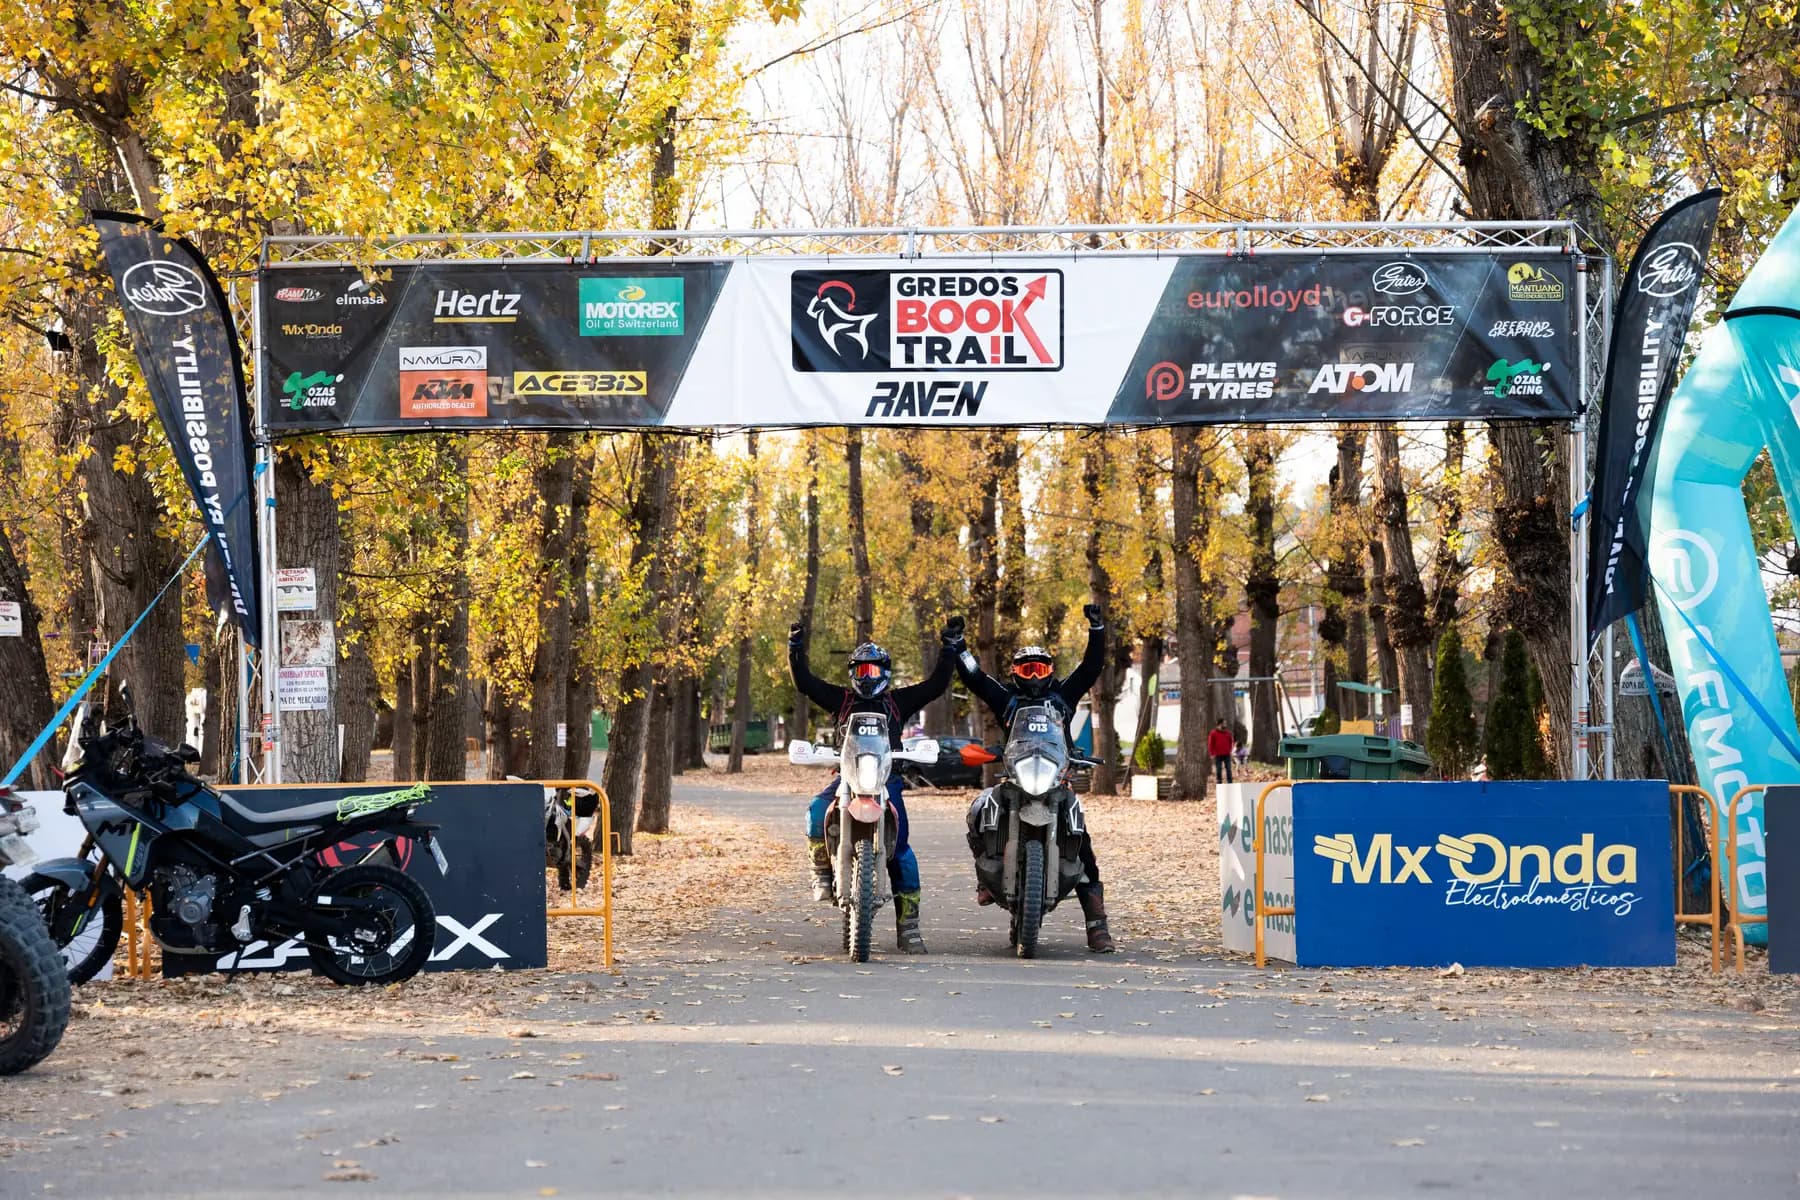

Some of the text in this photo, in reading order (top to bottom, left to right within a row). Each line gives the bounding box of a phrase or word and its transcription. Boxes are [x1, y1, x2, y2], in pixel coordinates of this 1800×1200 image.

[896, 276, 1019, 297] GREDOS
[1375, 266, 1424, 291] Gates
[336, 294, 384, 305] elmasa
[434, 290, 521, 316] Hertz
[1187, 283, 1321, 312] eurolloyd
[585, 302, 678, 319] MOTOREX
[1343, 306, 1455, 327] G-FORCE
[305, 323, 343, 335] Onda
[586, 319, 679, 328] Oil of Switzerland
[403, 355, 475, 365] NAMURA
[1190, 361, 1277, 380] PLEWS
[1307, 363, 1415, 394] ATOM
[412, 379, 475, 400] KTM
[865, 381, 989, 417] RAVEN
[1189, 381, 1274, 400] TYRES
[858, 726, 879, 736] 015
[1028, 723, 1048, 733] 013
[1314, 833, 1637, 885] Mx Onda
[1445, 874, 1643, 916] Electrodomésticos
